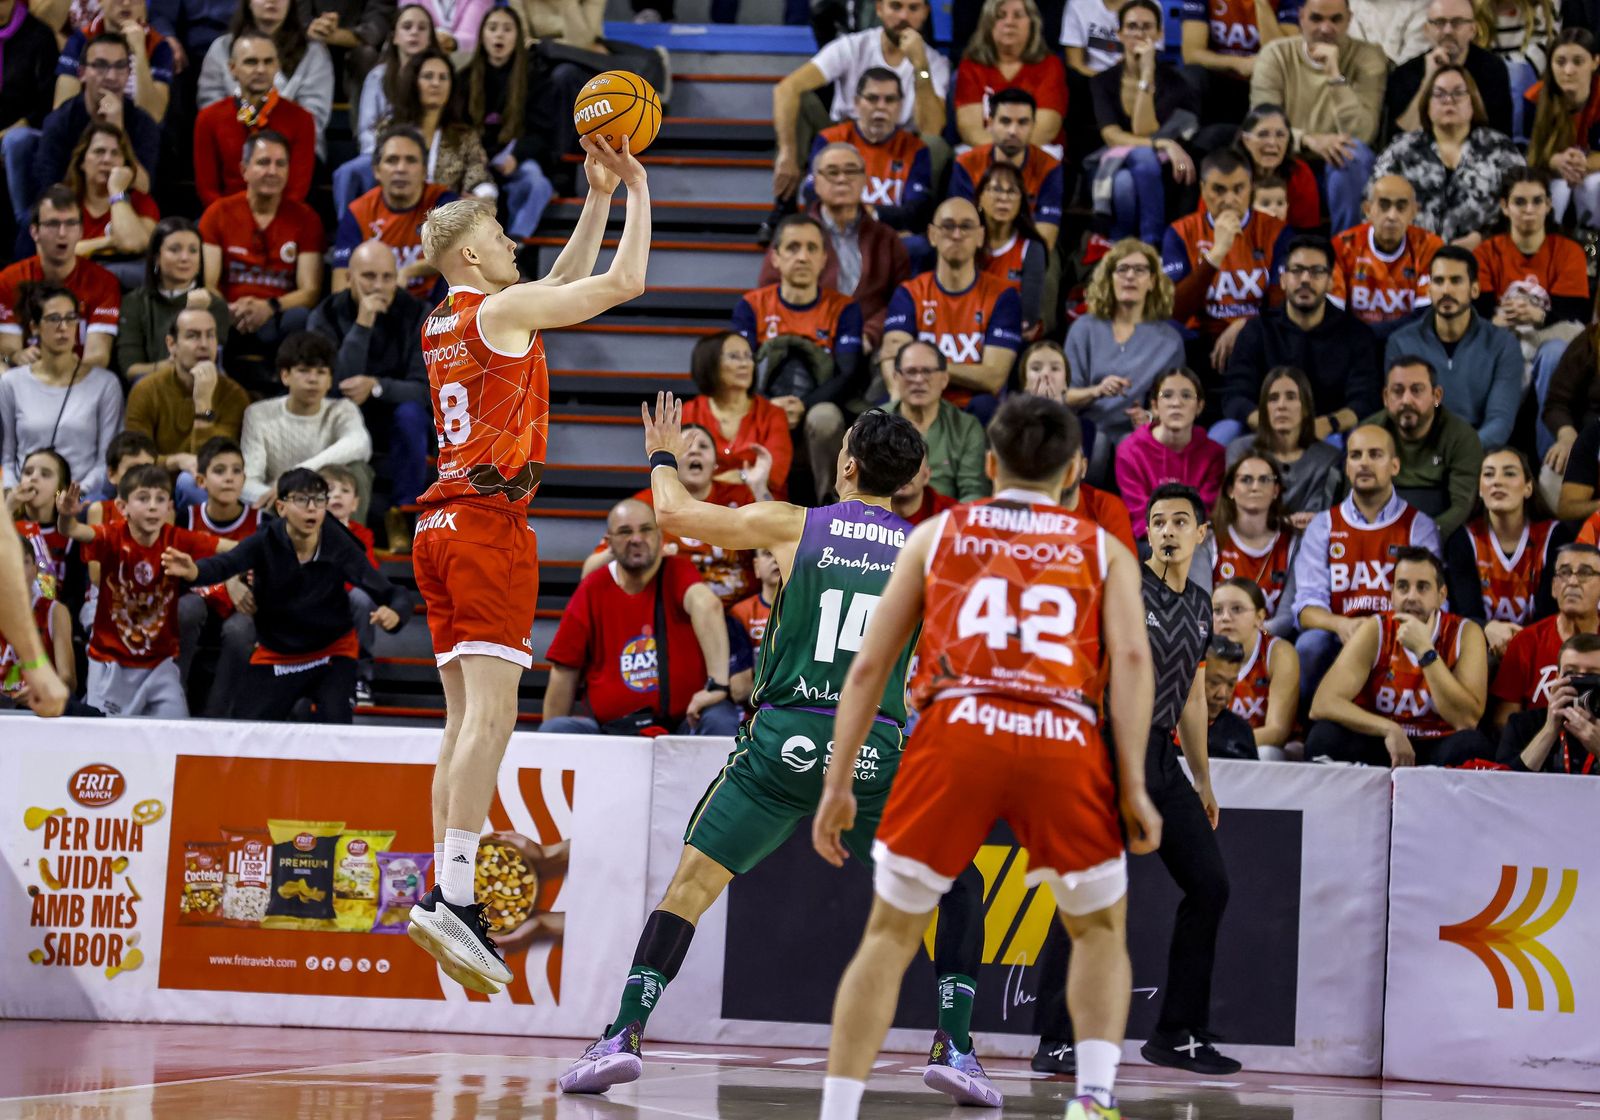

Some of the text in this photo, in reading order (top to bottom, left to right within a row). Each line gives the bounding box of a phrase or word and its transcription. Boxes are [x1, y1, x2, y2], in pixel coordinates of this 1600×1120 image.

[574, 98, 614, 124] Wilso
[1331, 560, 1395, 592] BAX
[957, 575, 1078, 667] 42
[620, 649, 659, 673] BAX
[1375, 685, 1437, 718] BAX
[75, 773, 119, 791] FRIT
[78, 790, 112, 799] RAVICH
[43, 816, 143, 852] PER UNA
[57, 855, 113, 890] VIDA
[243, 862, 263, 870] TOP
[279, 858, 329, 869] PREMIUM
[30, 892, 138, 929] AMB MÉS
[42, 932, 124, 967] SABOR
[208, 954, 298, 969] www.fritravich.com
